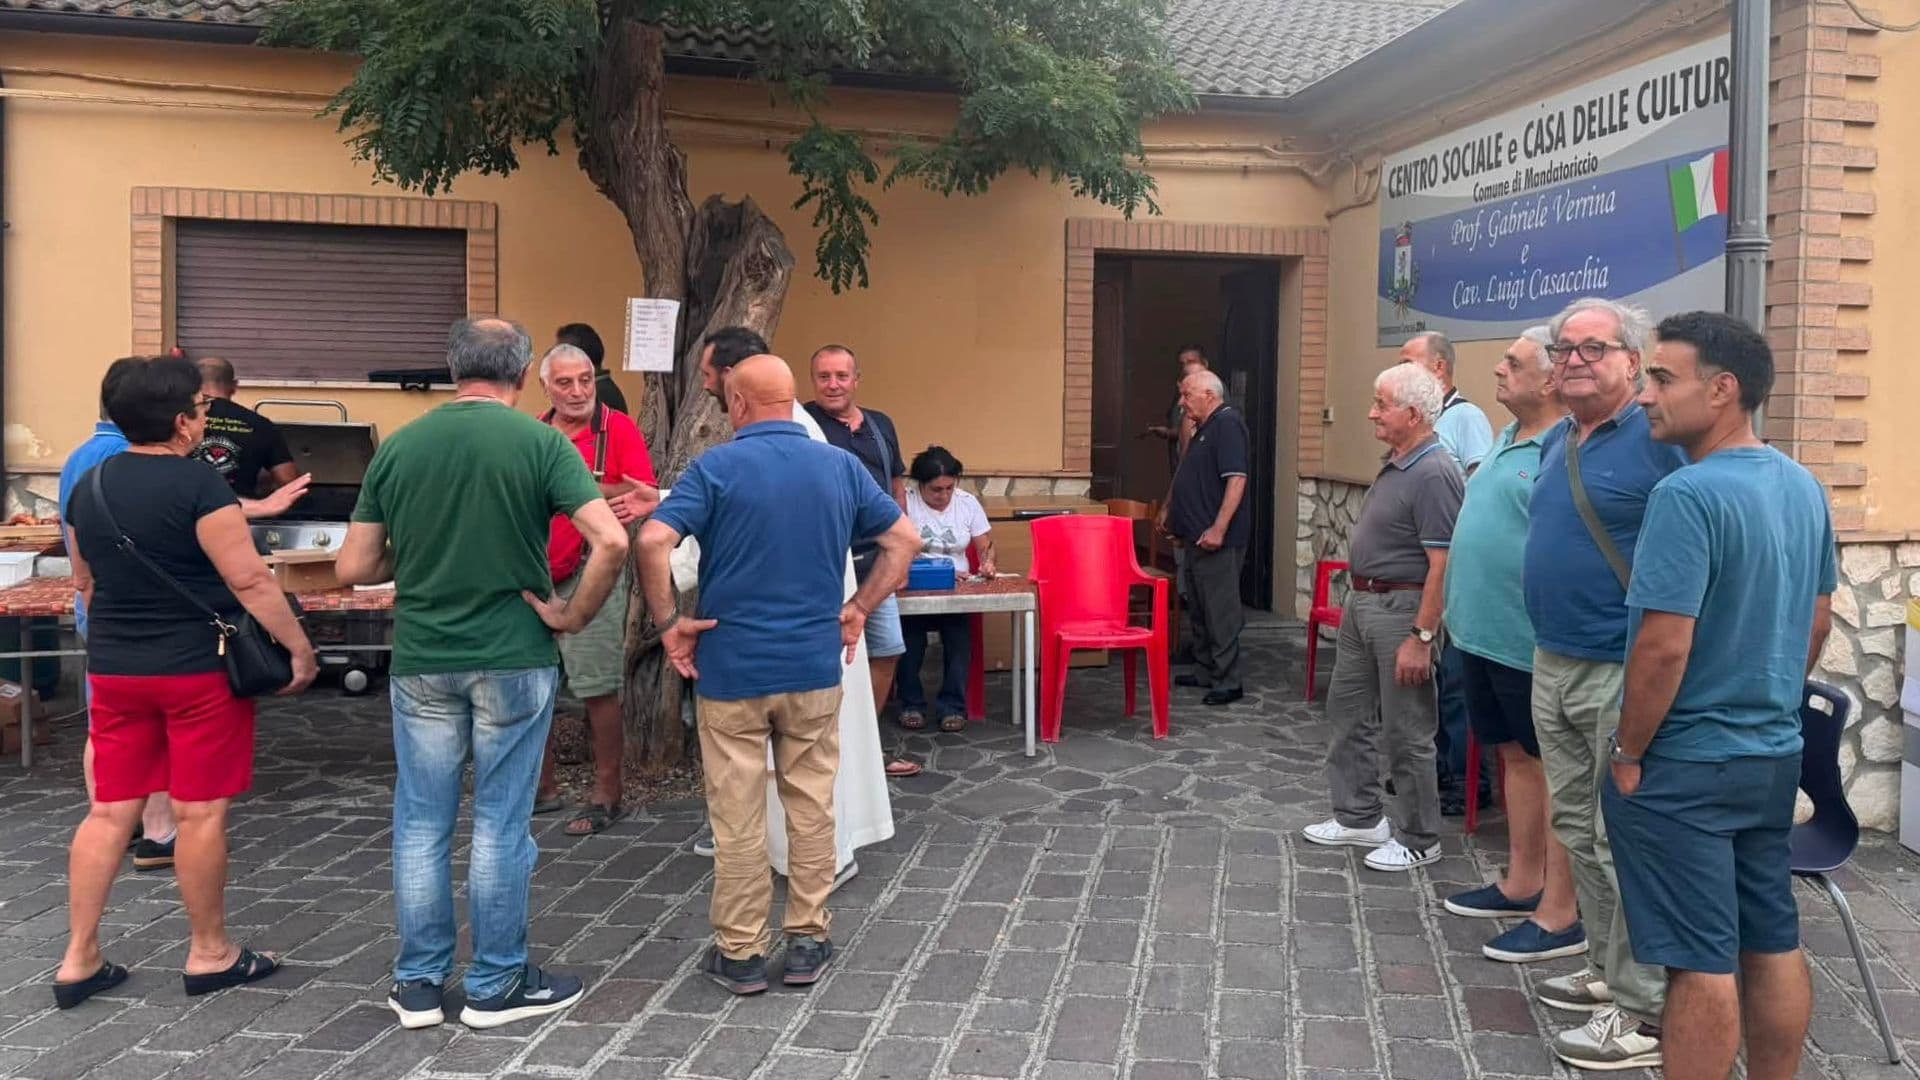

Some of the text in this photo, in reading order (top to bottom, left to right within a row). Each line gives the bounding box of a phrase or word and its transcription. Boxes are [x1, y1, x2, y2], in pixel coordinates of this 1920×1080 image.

[1388, 56, 1730, 199] CENTRO SOCIALE e CASA DELLE CULTUR
[1473, 152, 1599, 203] Comune di Mandatoriccio
[1451, 188, 1616, 251] Prof. Gabriele Verrina
[1521, 243, 1529, 265] e
[1452, 256, 1609, 310] Cav. Luigi Casacchia
